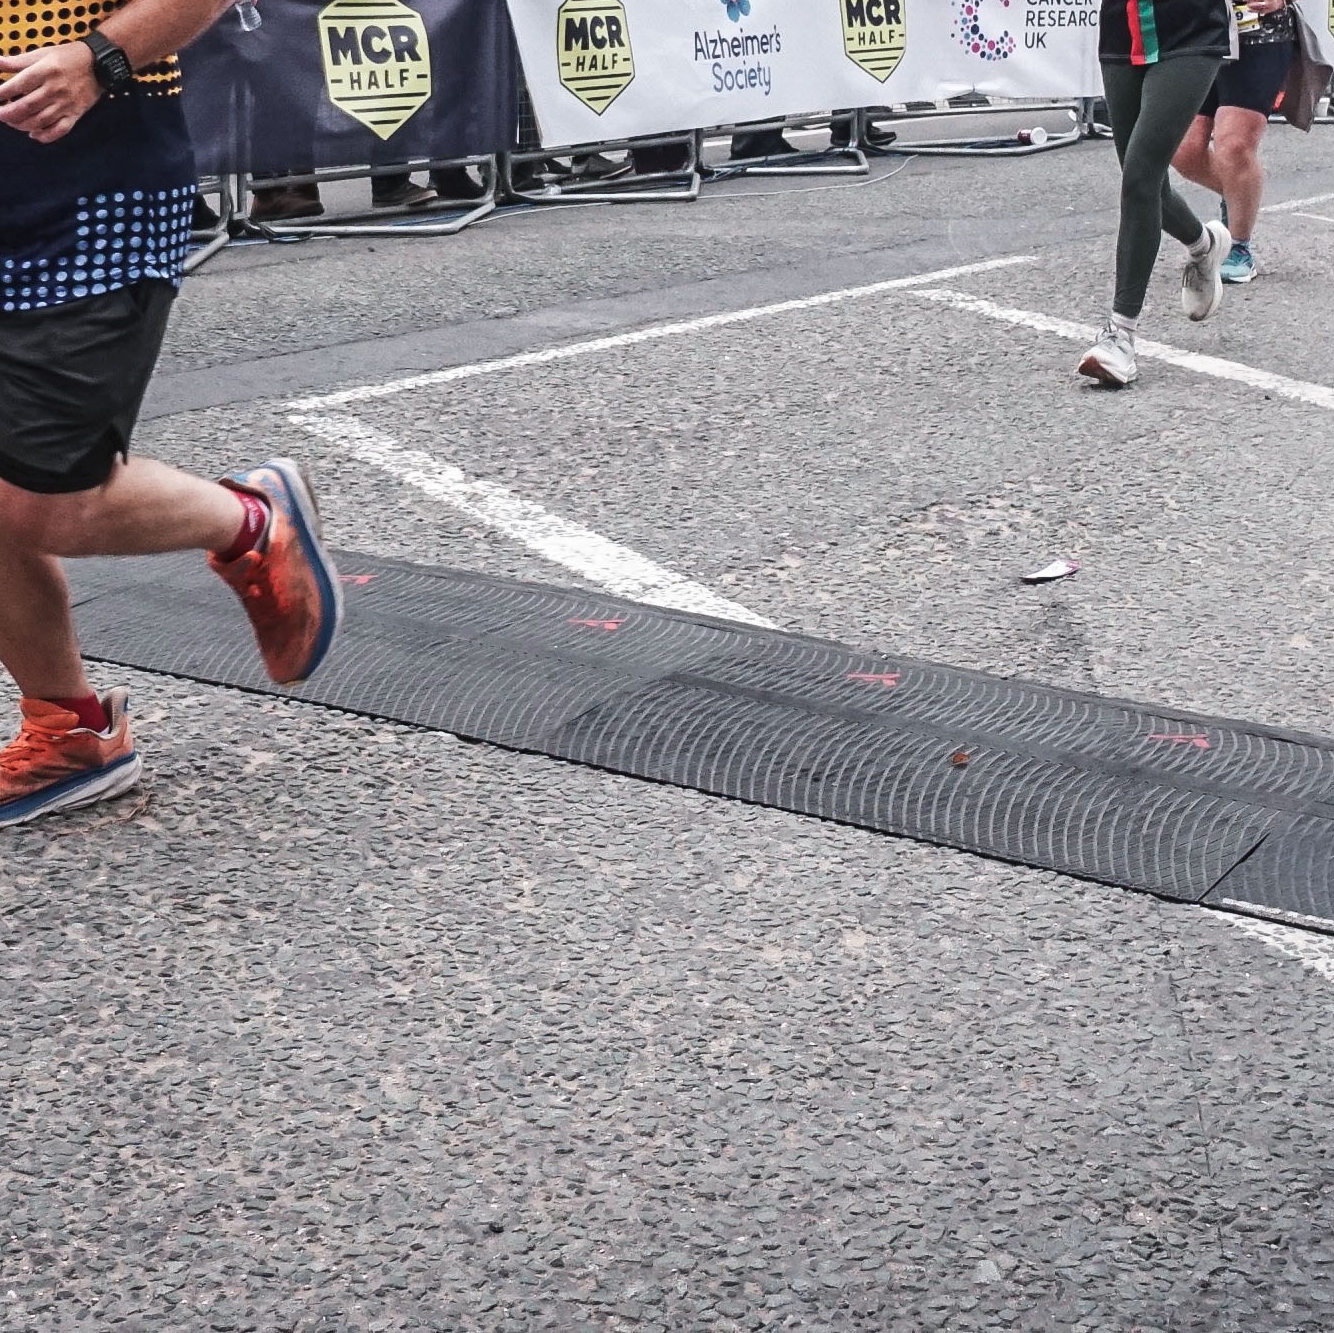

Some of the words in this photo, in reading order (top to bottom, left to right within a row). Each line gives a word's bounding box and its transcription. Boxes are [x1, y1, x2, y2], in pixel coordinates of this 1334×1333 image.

[1026, 10, 1098, 27] RESEARC
[564, 16, 625, 51] MCR
[694, 24, 781, 61] Alzheimer's
[858, 30, 895, 46] HALF
[1025, 32, 1047, 49] UK
[327, 25, 422, 66] MCR
[576, 53, 618, 72] HALF
[349, 69, 409, 90] HALF
[712, 61, 771, 96] Society
